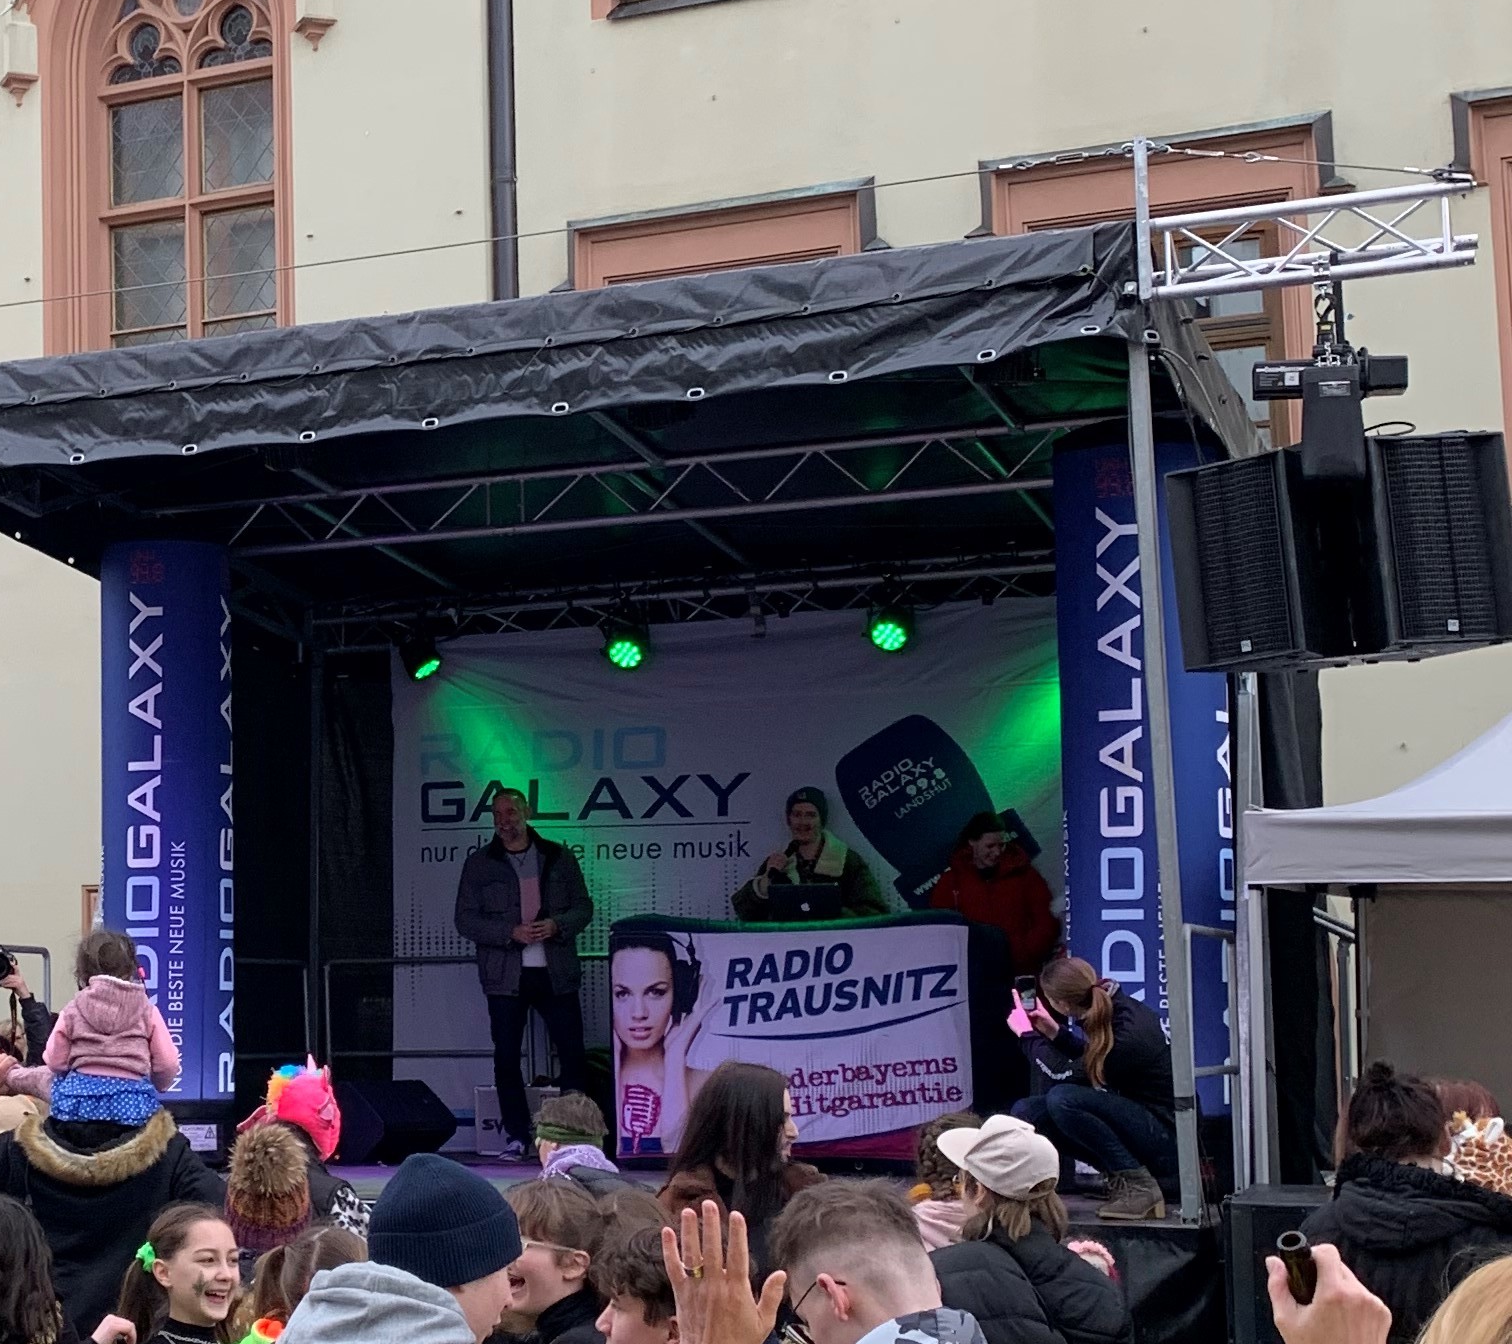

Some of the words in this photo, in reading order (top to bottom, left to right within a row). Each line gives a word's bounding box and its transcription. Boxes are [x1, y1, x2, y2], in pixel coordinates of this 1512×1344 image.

[858, 757, 914, 801] RADIO
[1095, 506, 1145, 1002] DIOGALAXY
[125, 591, 164, 1005] DIOGALAXY
[420, 771, 752, 824] GALAXY
[864, 755, 935, 810] GALAXY
[892, 777, 953, 821] LANDSHUT
[170, 840, 187, 900] MUSIK
[420, 844, 459, 863] nur
[466, 834, 490, 857] di
[595, 838, 663, 860] neue
[673, 829, 751, 859] musik
[169, 904, 186, 955] NEUE
[168, 959, 185, 1011] BESTE
[725, 942, 854, 990] RADIO
[723, 964, 958, 1027] TRAUSNITZ
[788, 1056, 958, 1090] derbayerns
